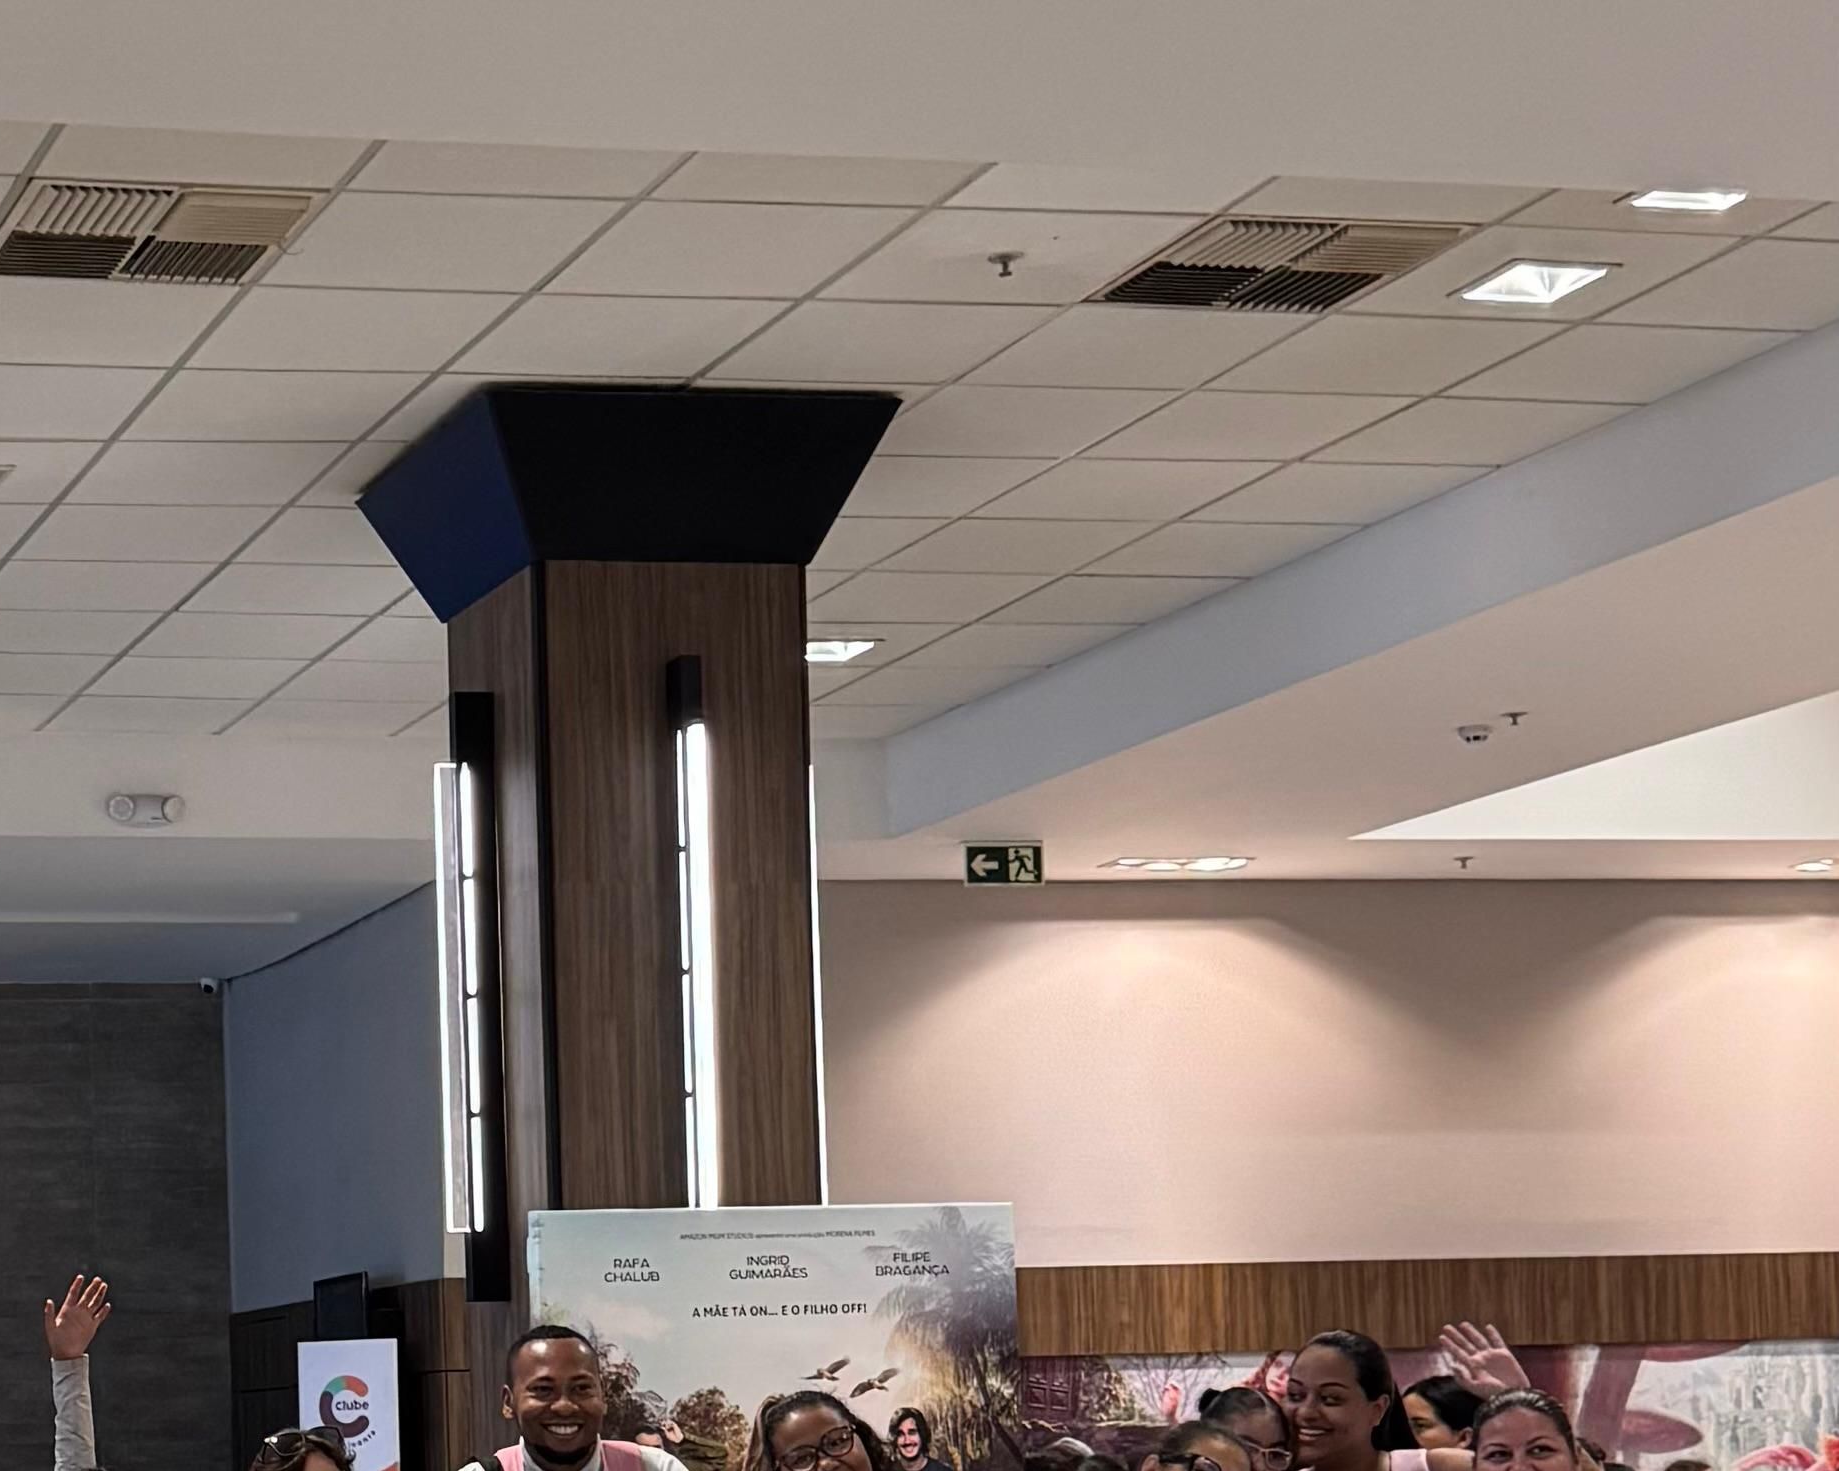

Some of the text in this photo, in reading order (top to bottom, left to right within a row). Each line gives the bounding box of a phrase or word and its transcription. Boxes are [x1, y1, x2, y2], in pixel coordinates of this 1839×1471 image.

[613, 1257, 650, 1269] RAFA
[746, 1255, 790, 1267] INGRID
[892, 1251, 931, 1263] FILIPE
[729, 1265, 808, 1280] GUIMARÃES
[875, 1264, 950, 1277] BRAGANÇA
[604, 1271, 660, 1283] CHALUB
[692, 1307, 701, 1318] A
[703, 1304, 729, 1318] MÃE
[731, 1304, 747, 1317] TÁ
[781, 1305, 788, 1316] E
[791, 1304, 800, 1315] O
[804, 1303, 838, 1315] FILHO
[841, 1302, 867, 1314] OFF!
